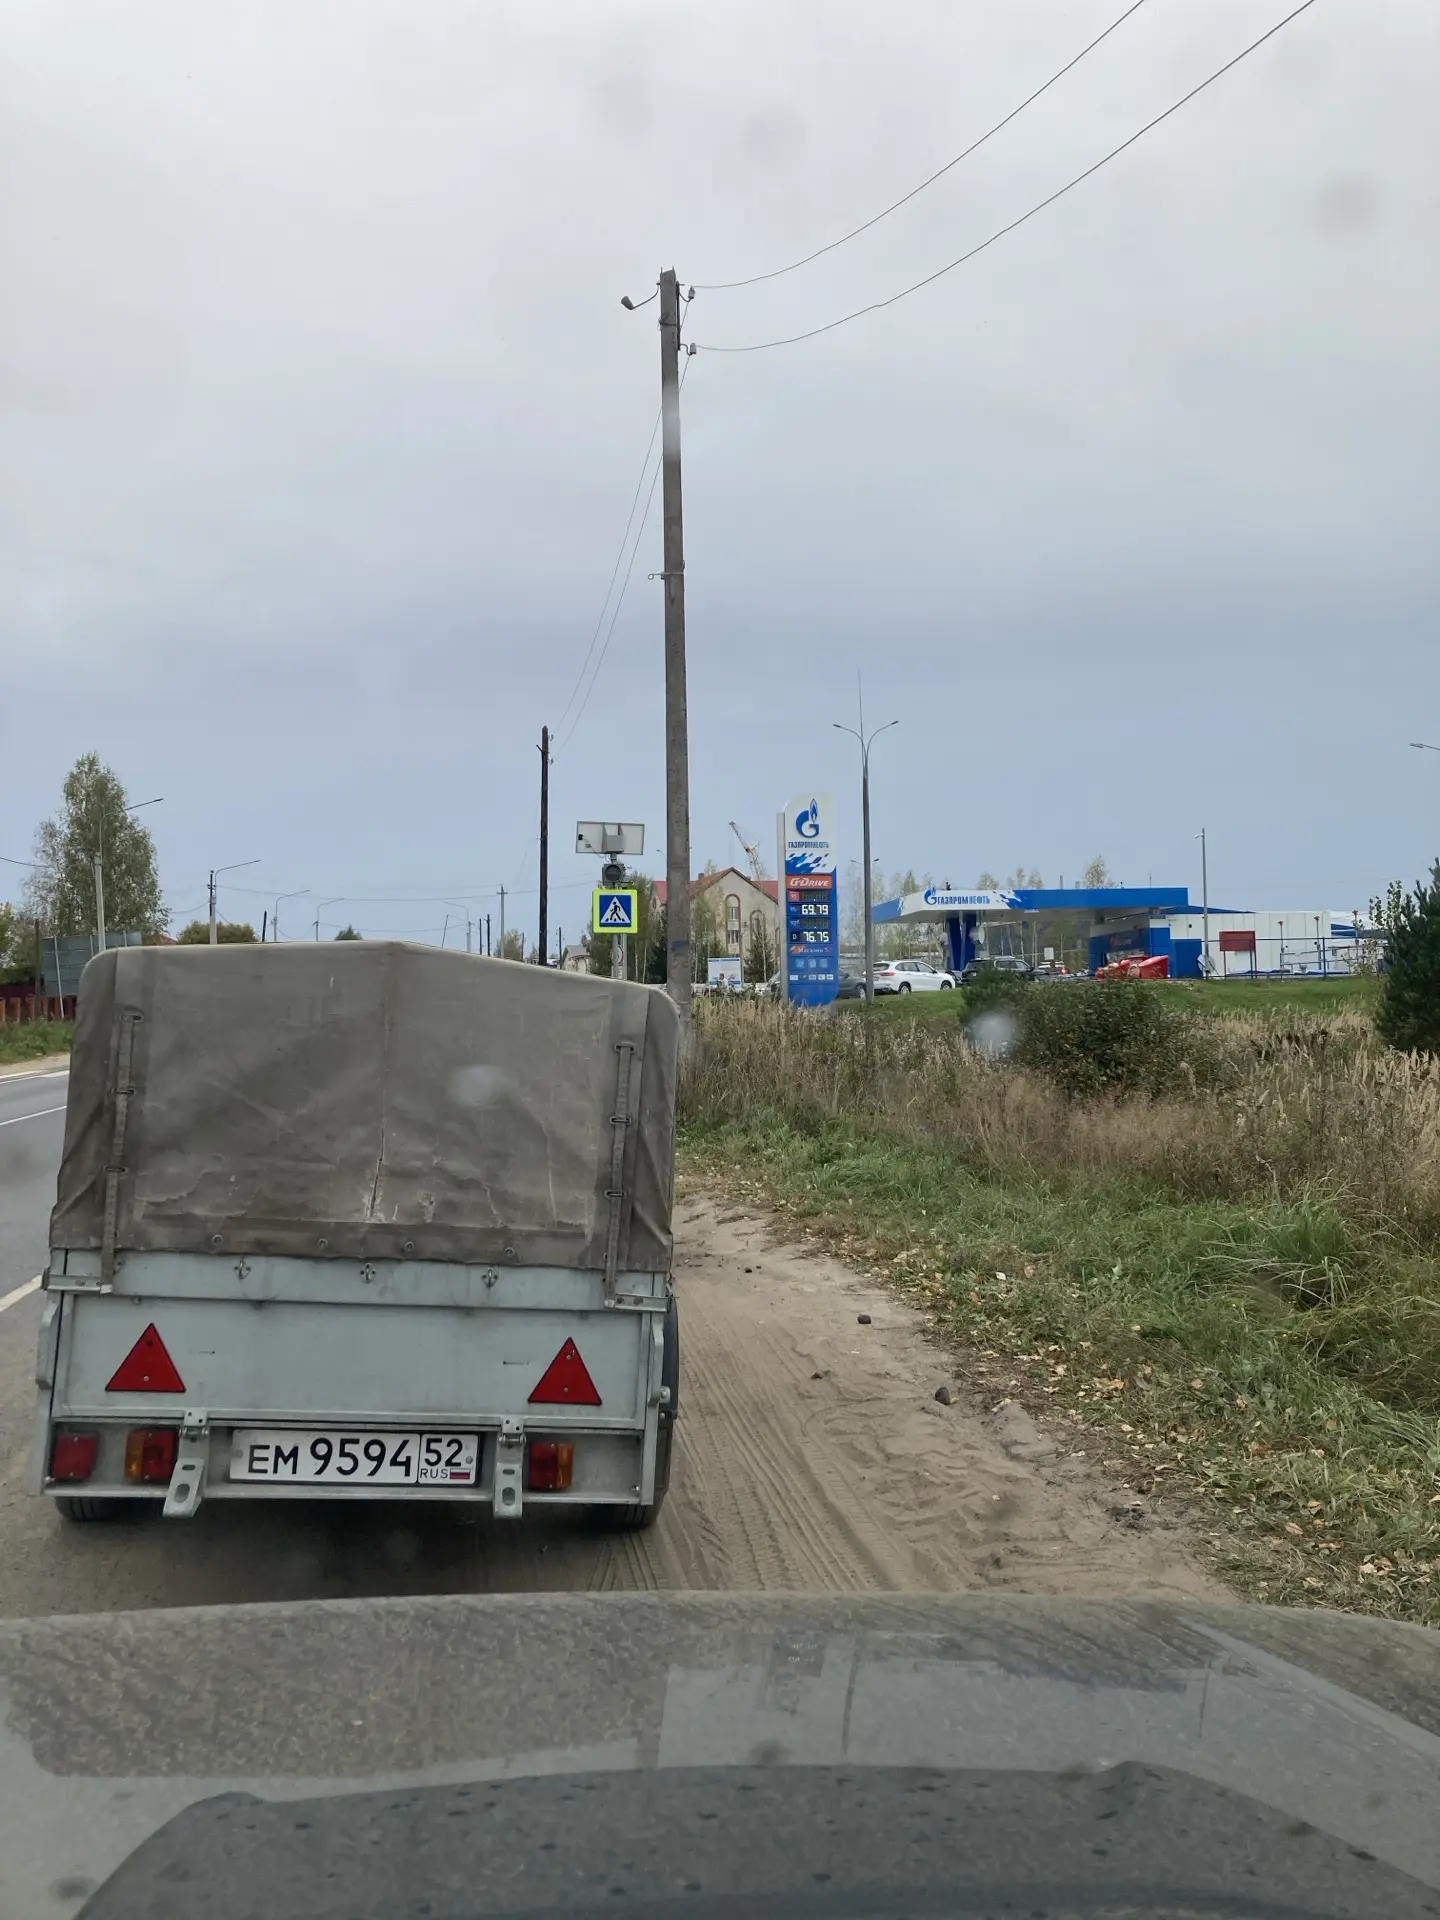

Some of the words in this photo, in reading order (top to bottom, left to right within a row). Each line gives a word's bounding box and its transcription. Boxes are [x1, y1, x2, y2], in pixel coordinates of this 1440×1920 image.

[801, 904, 829, 916] 69.79
[803, 931, 830, 943] 76.75
[310, 1437, 412, 1477] 9594
[424, 1438, 464, 1468] 52
[419, 1467, 449, 1480] RUS
